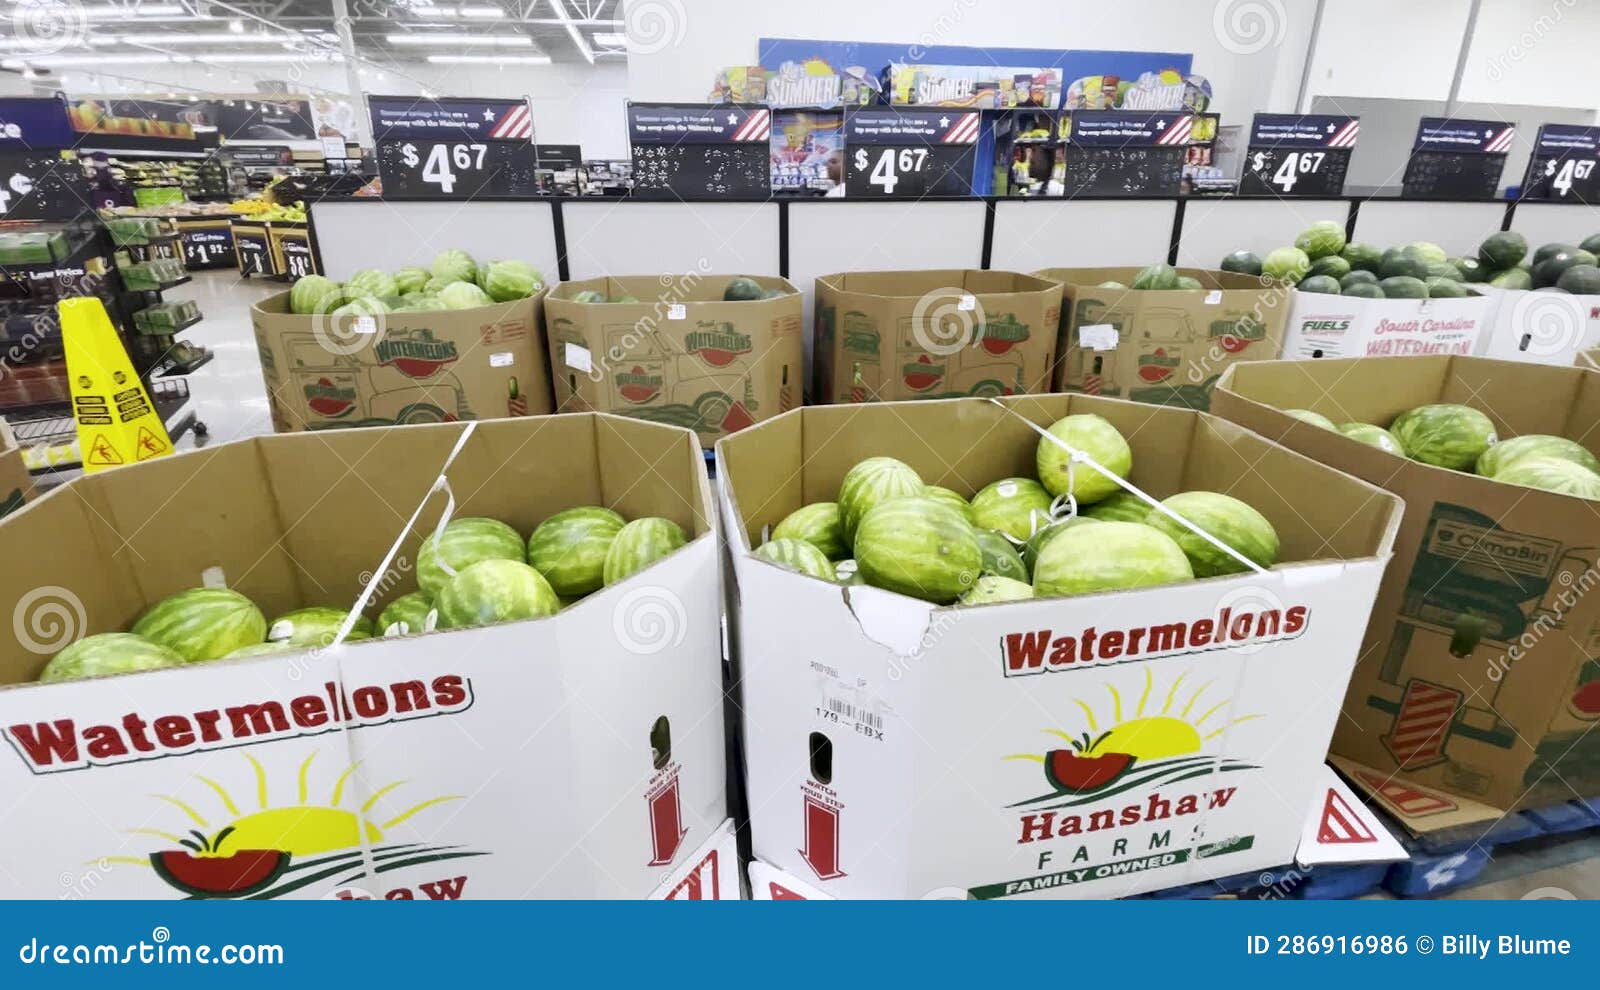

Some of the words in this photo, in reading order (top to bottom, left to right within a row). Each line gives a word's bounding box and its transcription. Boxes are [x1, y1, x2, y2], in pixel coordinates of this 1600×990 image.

[1374, 317, 1418, 335] South
[1421, 318, 1476, 333] Carolina
[376, 340, 457, 361] WATERMELONS
[1457, 533, 1549, 563] ClimaBin
[1006, 605, 1307, 670] Watermelons
[8, 674, 466, 766] Watermelons
[1017, 787, 1238, 844] Hanshaw
[1005, 868, 1091, 894] FAMILY
[1095, 853, 1176, 878] OWNED
